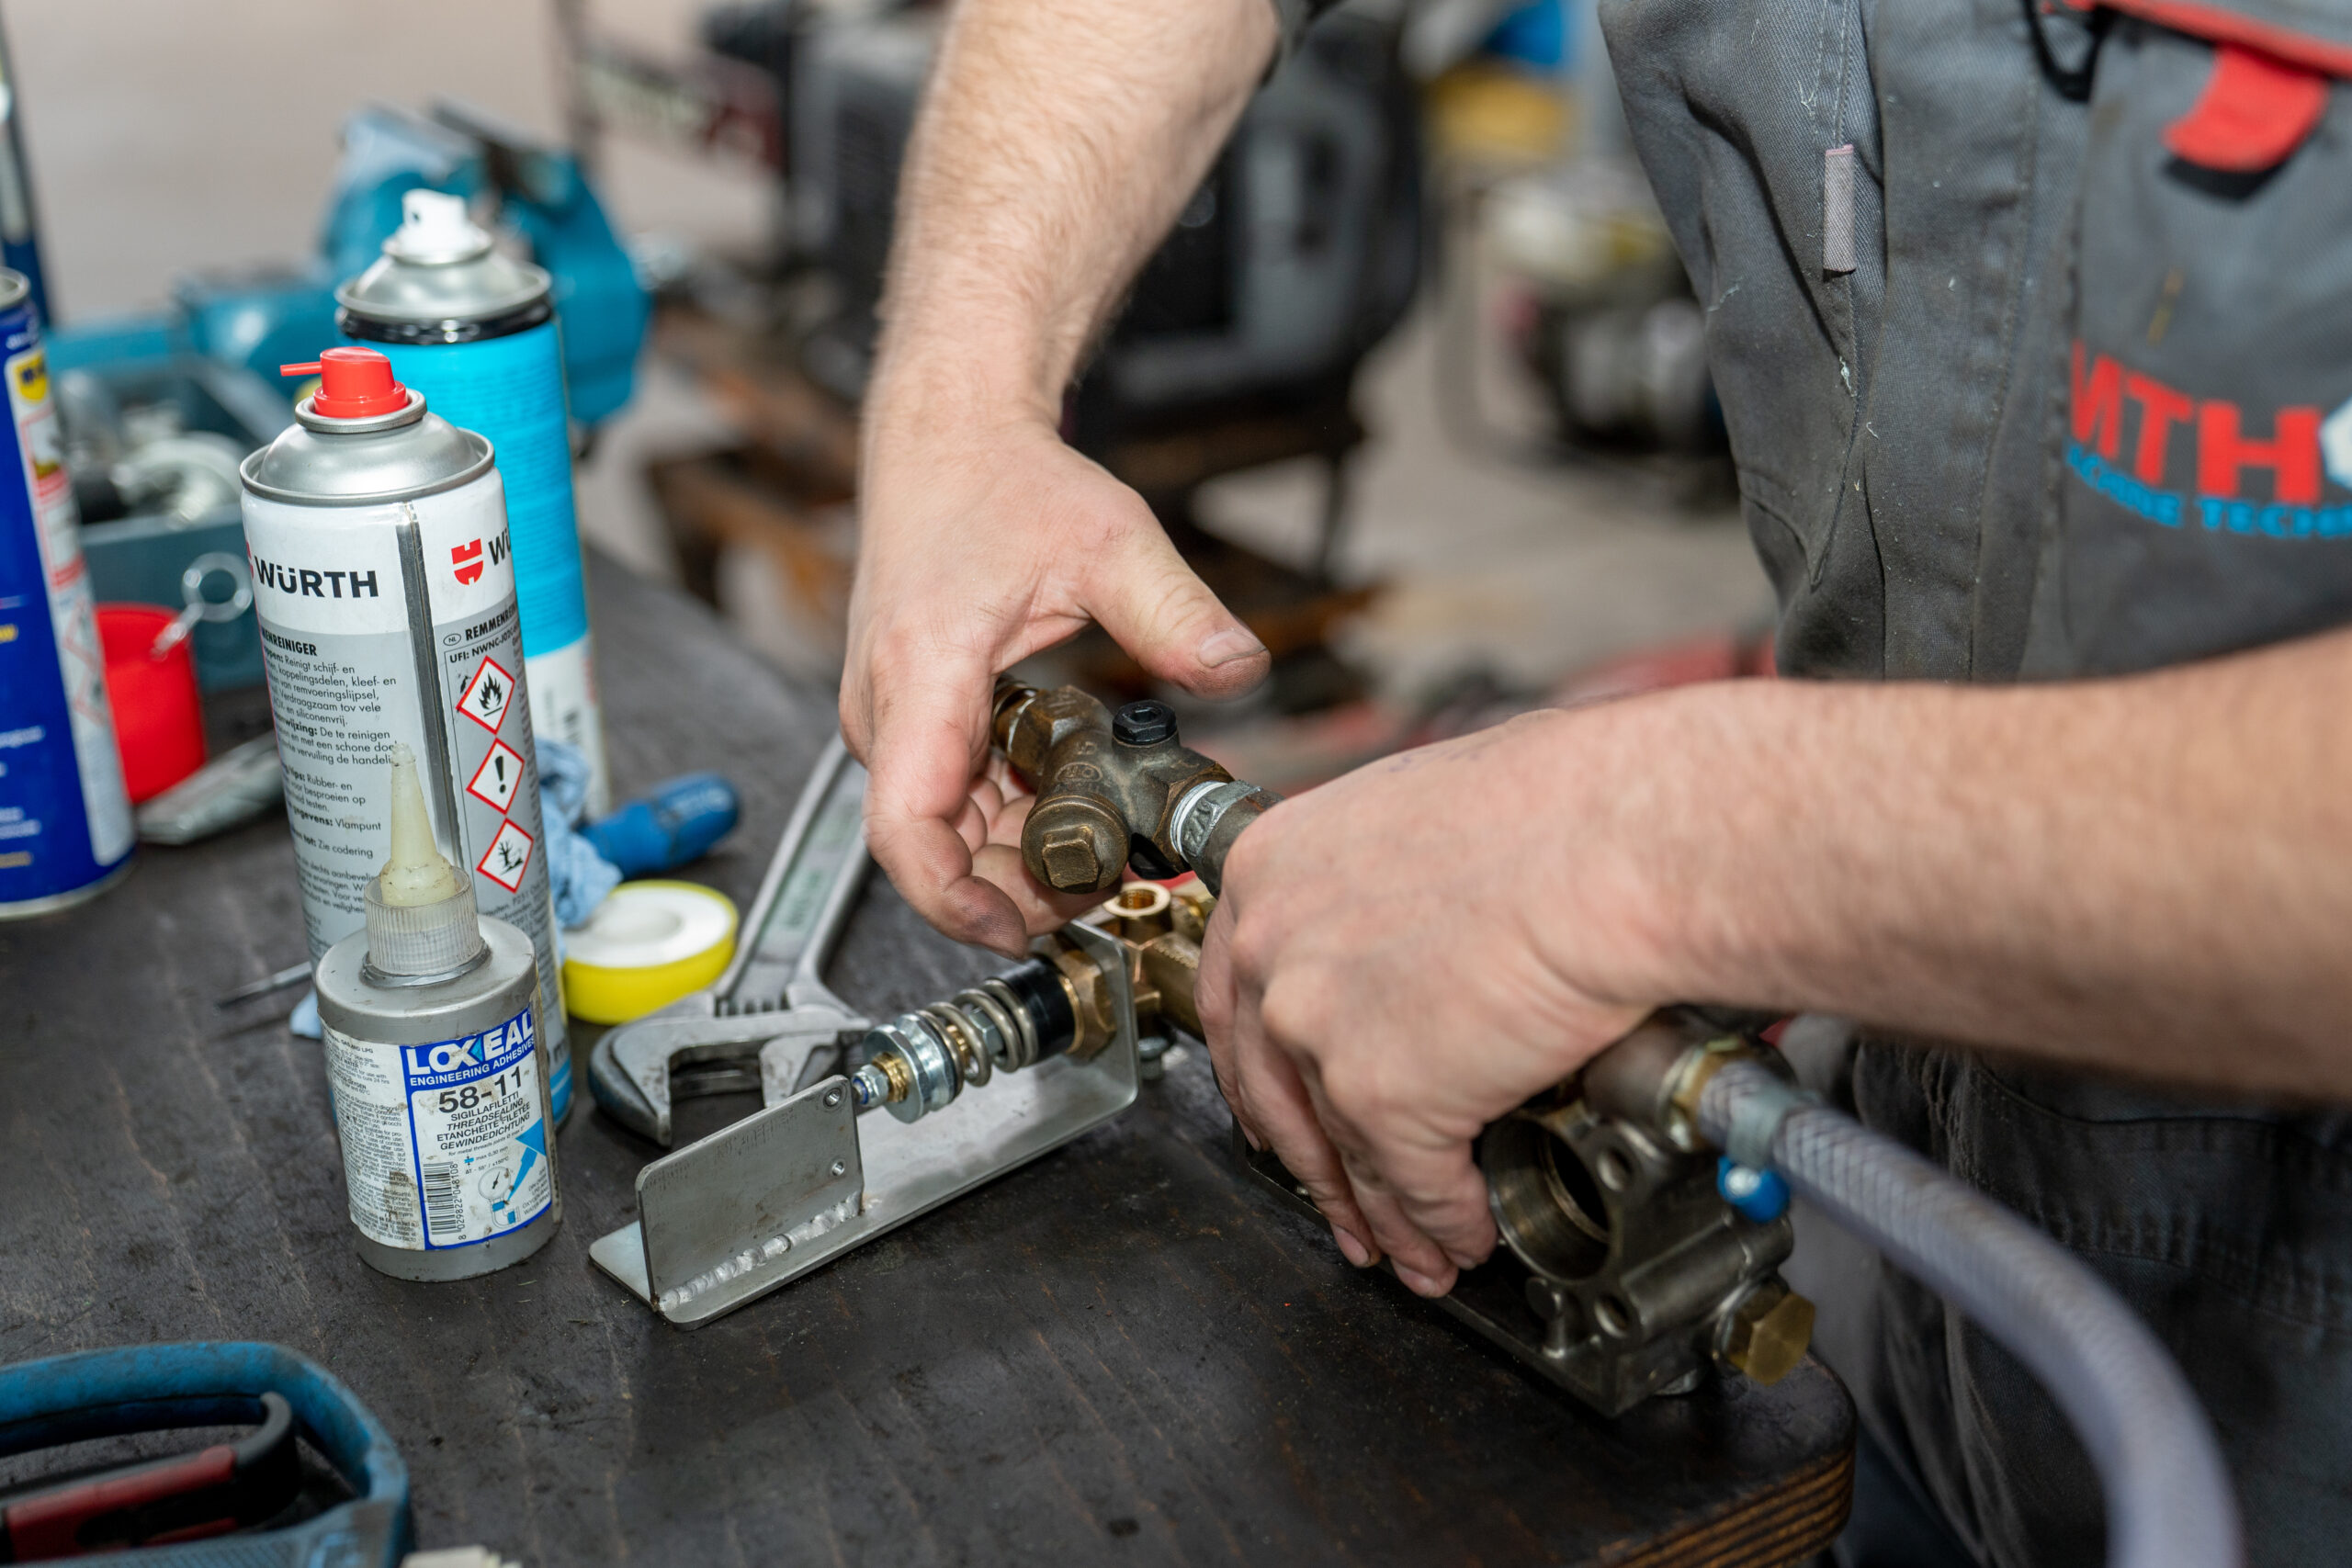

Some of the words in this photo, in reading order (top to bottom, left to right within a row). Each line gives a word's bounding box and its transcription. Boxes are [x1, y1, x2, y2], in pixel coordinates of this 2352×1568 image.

[254, 555, 379, 599] WÜRTH
[284, 655, 311, 672] Reinigt
[313, 662, 339, 675] schijf-
[449, 650, 469, 663] UFI:
[278, 665, 348, 687] koppelingsdelen,
[351, 676, 379, 687] kleef-
[293, 684, 379, 702] remvoeringslijpsel,
[341, 704, 356, 712] tov
[359, 702, 381, 713] vele
[296, 708, 348, 727] siliconenvrij.
[301, 736, 314, 747] met
[316, 741, 333, 750] een
[335, 741, 371, 752] schone
[320, 727, 333, 738] De
[335, 730, 345, 739] te
[348, 730, 390, 742] reinigen
[298, 747, 334, 765] vervuiling
[336, 755, 349, 764] de
[352, 753, 392, 765] handeli
[304, 784, 349, 804] besproeien
[352, 796, 366, 807] op
[341, 783, 353, 791] en
[334, 818, 381, 832] Vlampunt
[332, 844, 374, 859] codering
[405, 1011, 534, 1076] LOXEAL
[410, 1064, 490, 1088] ENGINEERING
[438, 1065, 522, 1114] 58-11
[447, 1098, 524, 1132] THREADSEALING
[450, 1090, 519, 1122] SIGILLAFILETTI
[440, 1111, 530, 1151] GEWINDEDICHTUNG
